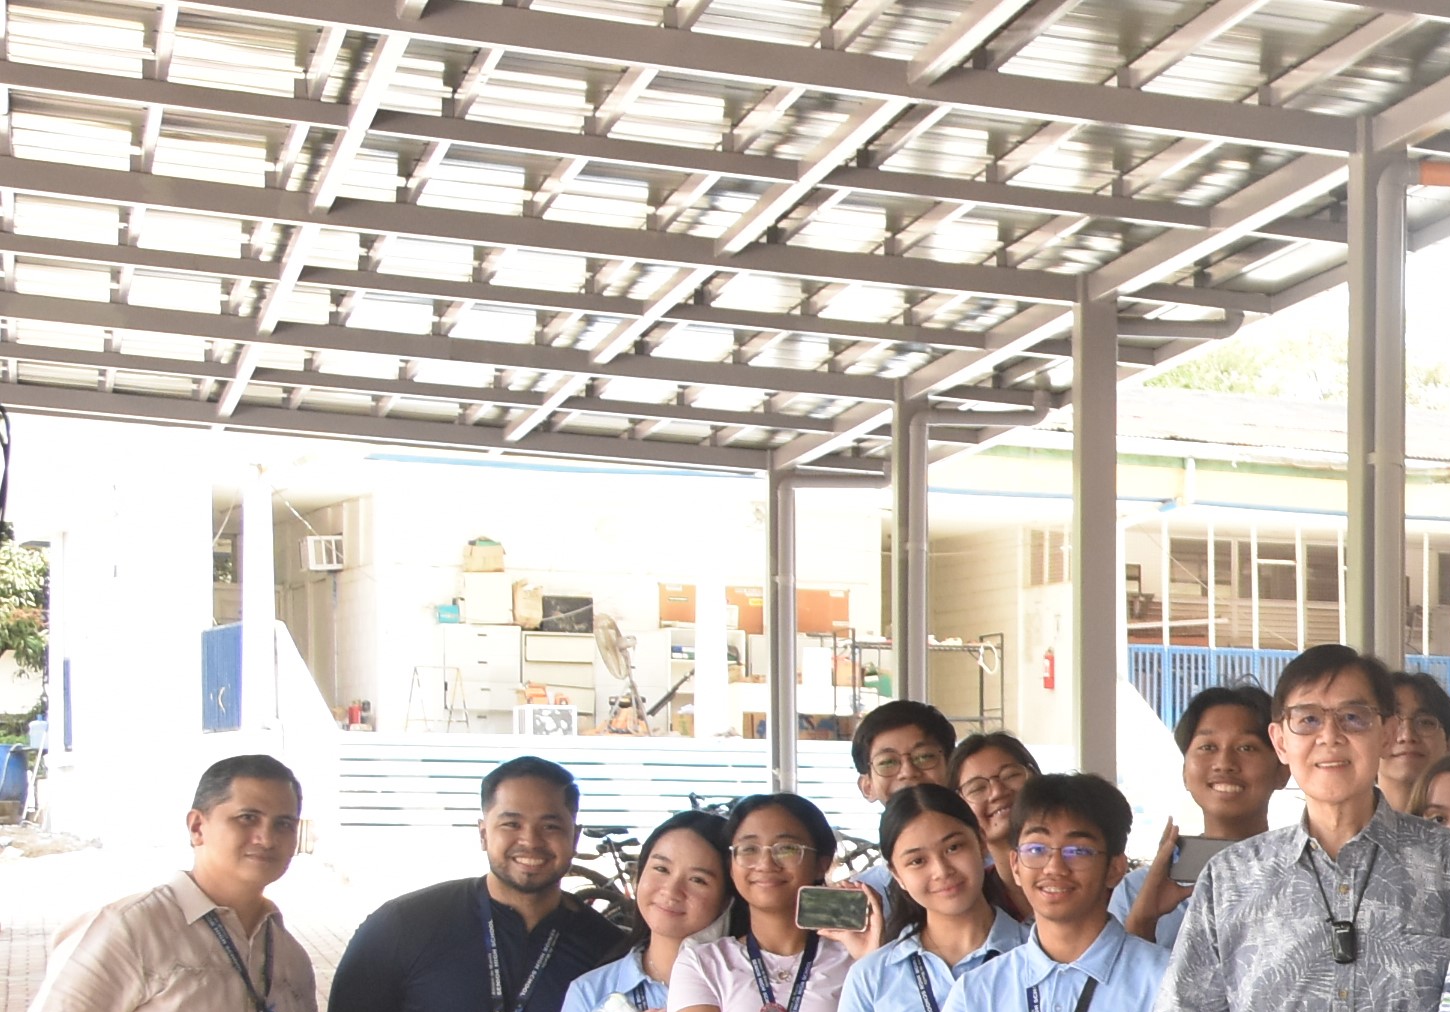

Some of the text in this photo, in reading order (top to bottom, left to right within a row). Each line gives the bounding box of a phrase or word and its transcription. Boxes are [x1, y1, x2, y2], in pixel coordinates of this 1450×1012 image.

[487, 919, 502, 996] SENIOR HIGH SCHOOL
[520, 970, 537, 997] SCHOOL
